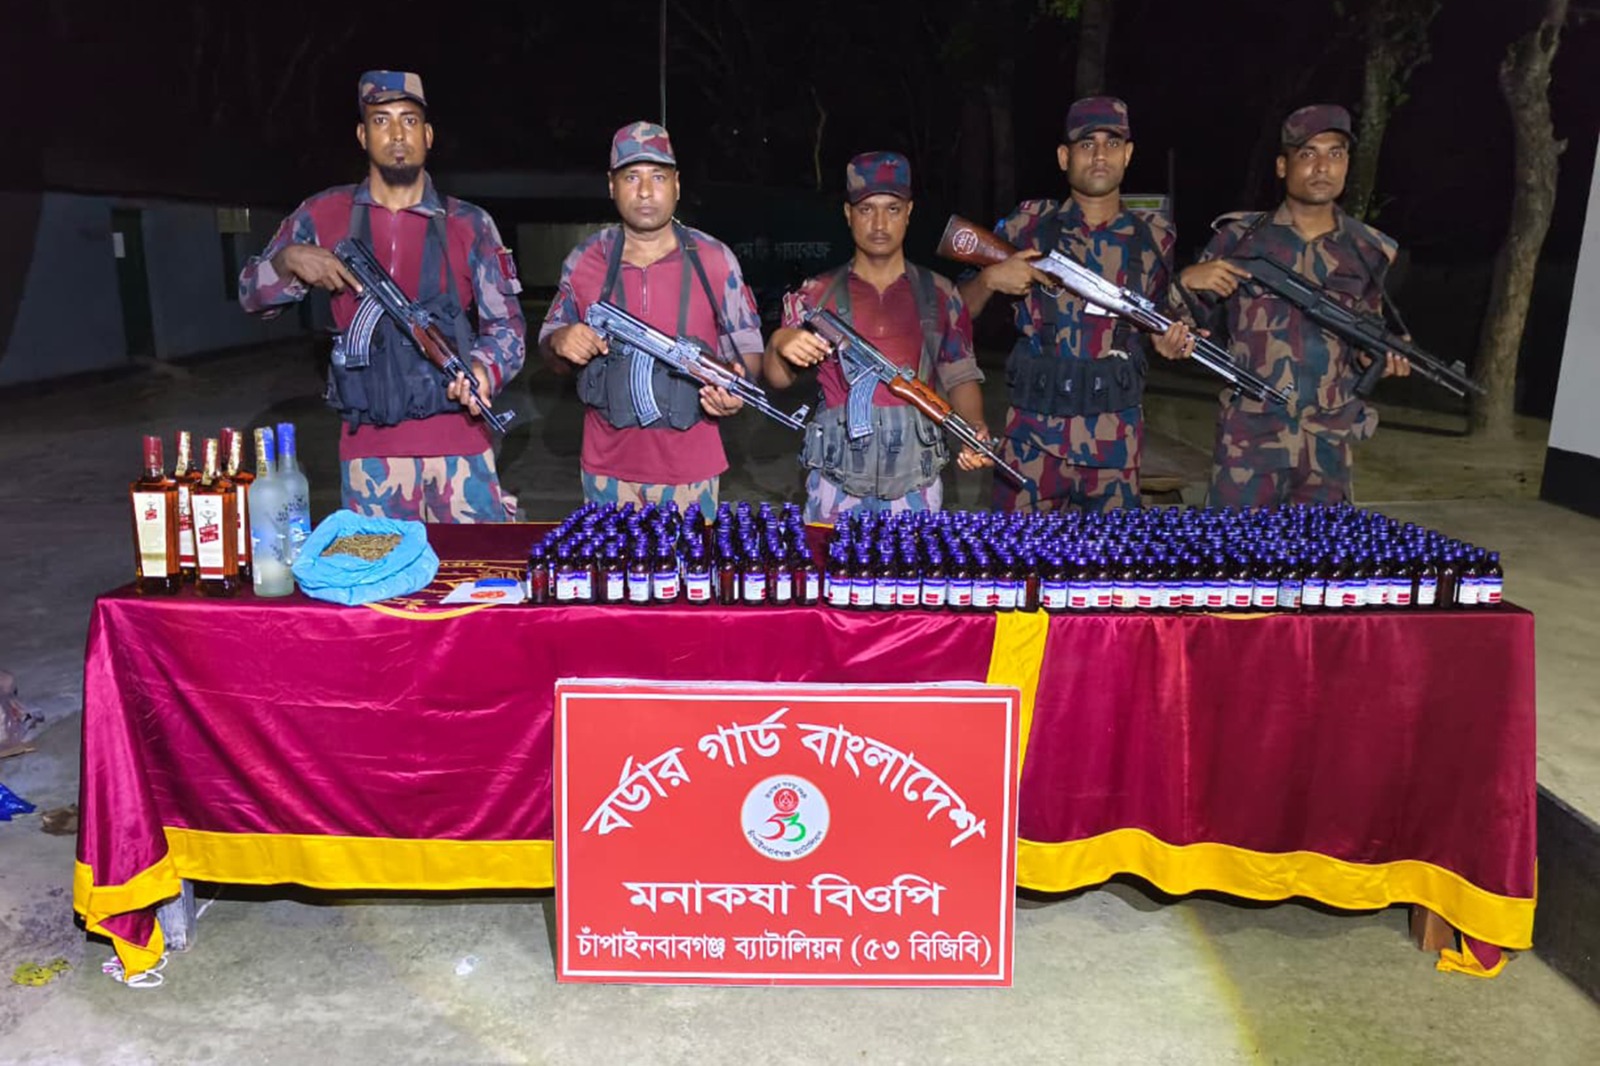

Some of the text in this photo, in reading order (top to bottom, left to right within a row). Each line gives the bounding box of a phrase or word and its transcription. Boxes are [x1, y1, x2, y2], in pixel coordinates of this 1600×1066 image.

[582, 707, 986, 848] বর্ডার গার্ড বাংলাদেশ
[623, 874, 946, 916] মনাকষা বিওপি
[576, 926, 991, 967] চাঁপাইনবাবগঞ্জ ব্যাটালিয়ন (৫৩ বিজিবি)
